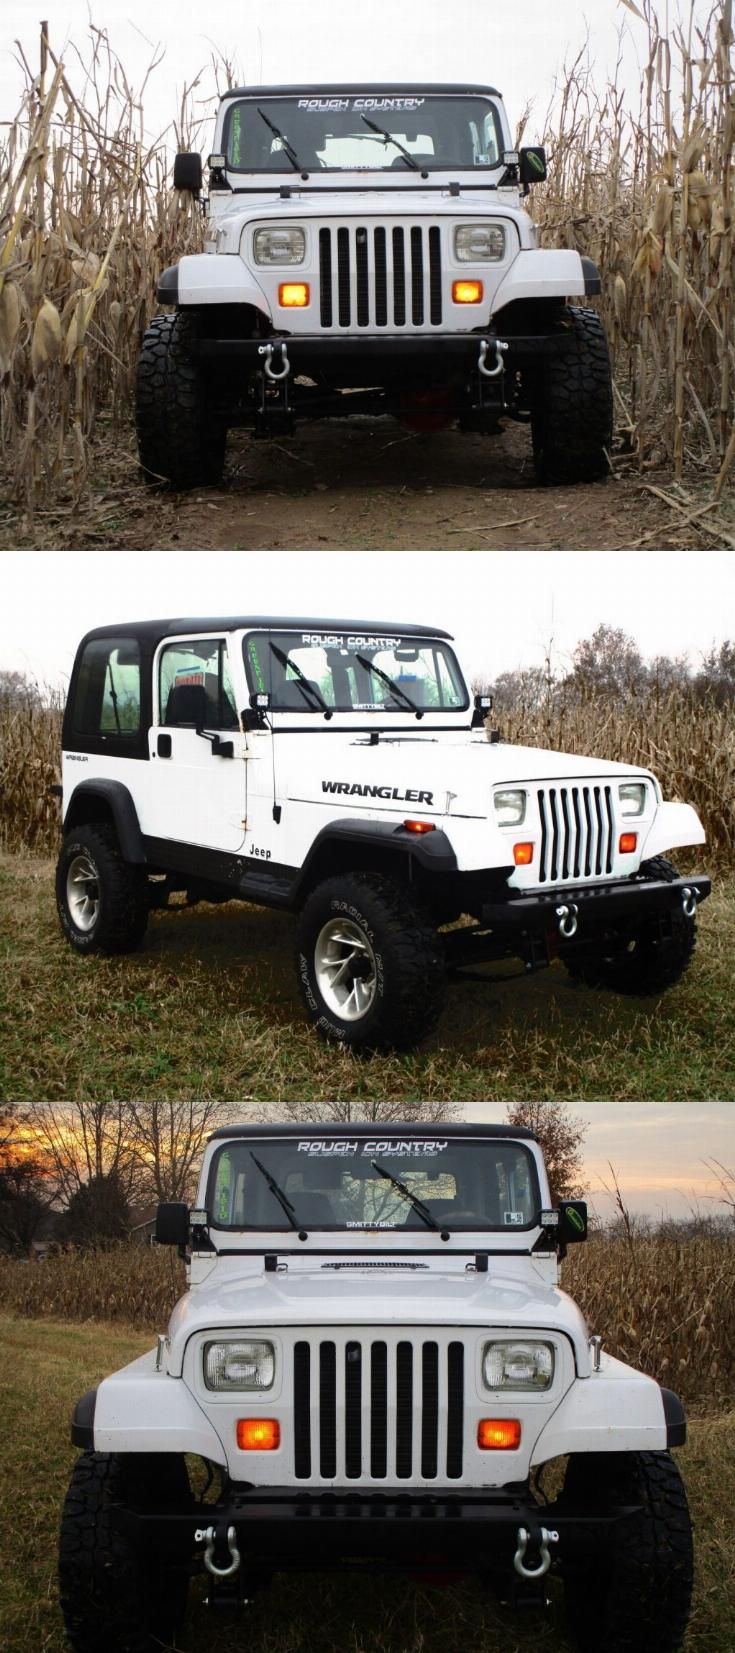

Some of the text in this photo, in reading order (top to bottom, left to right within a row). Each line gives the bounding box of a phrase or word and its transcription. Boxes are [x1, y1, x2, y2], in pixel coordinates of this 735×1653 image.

[298, 98, 425, 108] ROUGH COUNTRY
[302, 635, 401, 647] ROUGH COUNTRY
[321, 780, 434, 806] WRANGLER
[249, 843, 271, 861] Jeep
[297, 1141, 448, 1152] ROUGH COUNTRY
